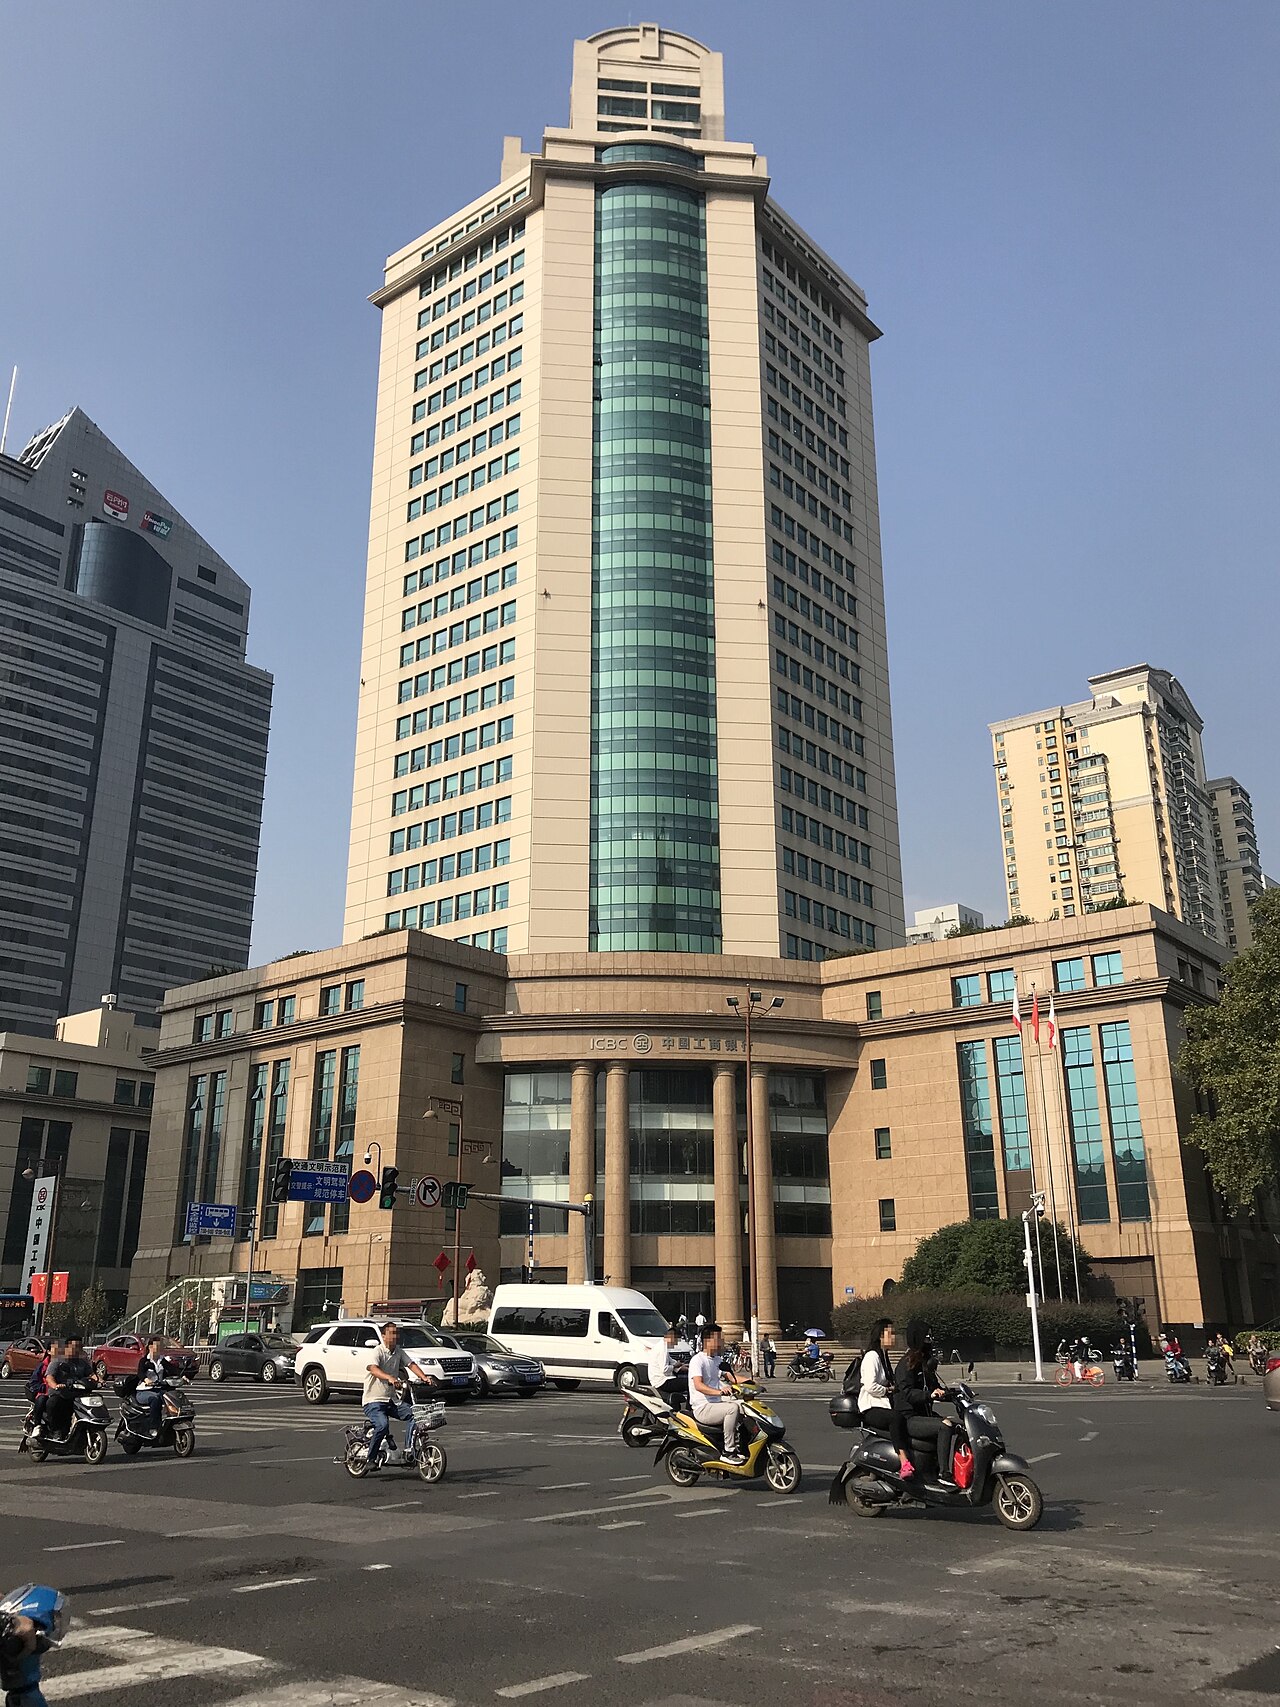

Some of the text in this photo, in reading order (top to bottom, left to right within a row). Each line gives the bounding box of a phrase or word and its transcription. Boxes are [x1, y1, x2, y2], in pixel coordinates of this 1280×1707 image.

[144, 514, 171, 532] UnionPay
[590, 1038, 627, 1050] ICBC
[661, 1036, 753, 1053] 中国工商银行
[293, 1161, 348, 1173] 交通文明示范路
[315, 1176, 346, 1187] 文明驾驶
[314, 1188, 345, 1199] 规范停车
